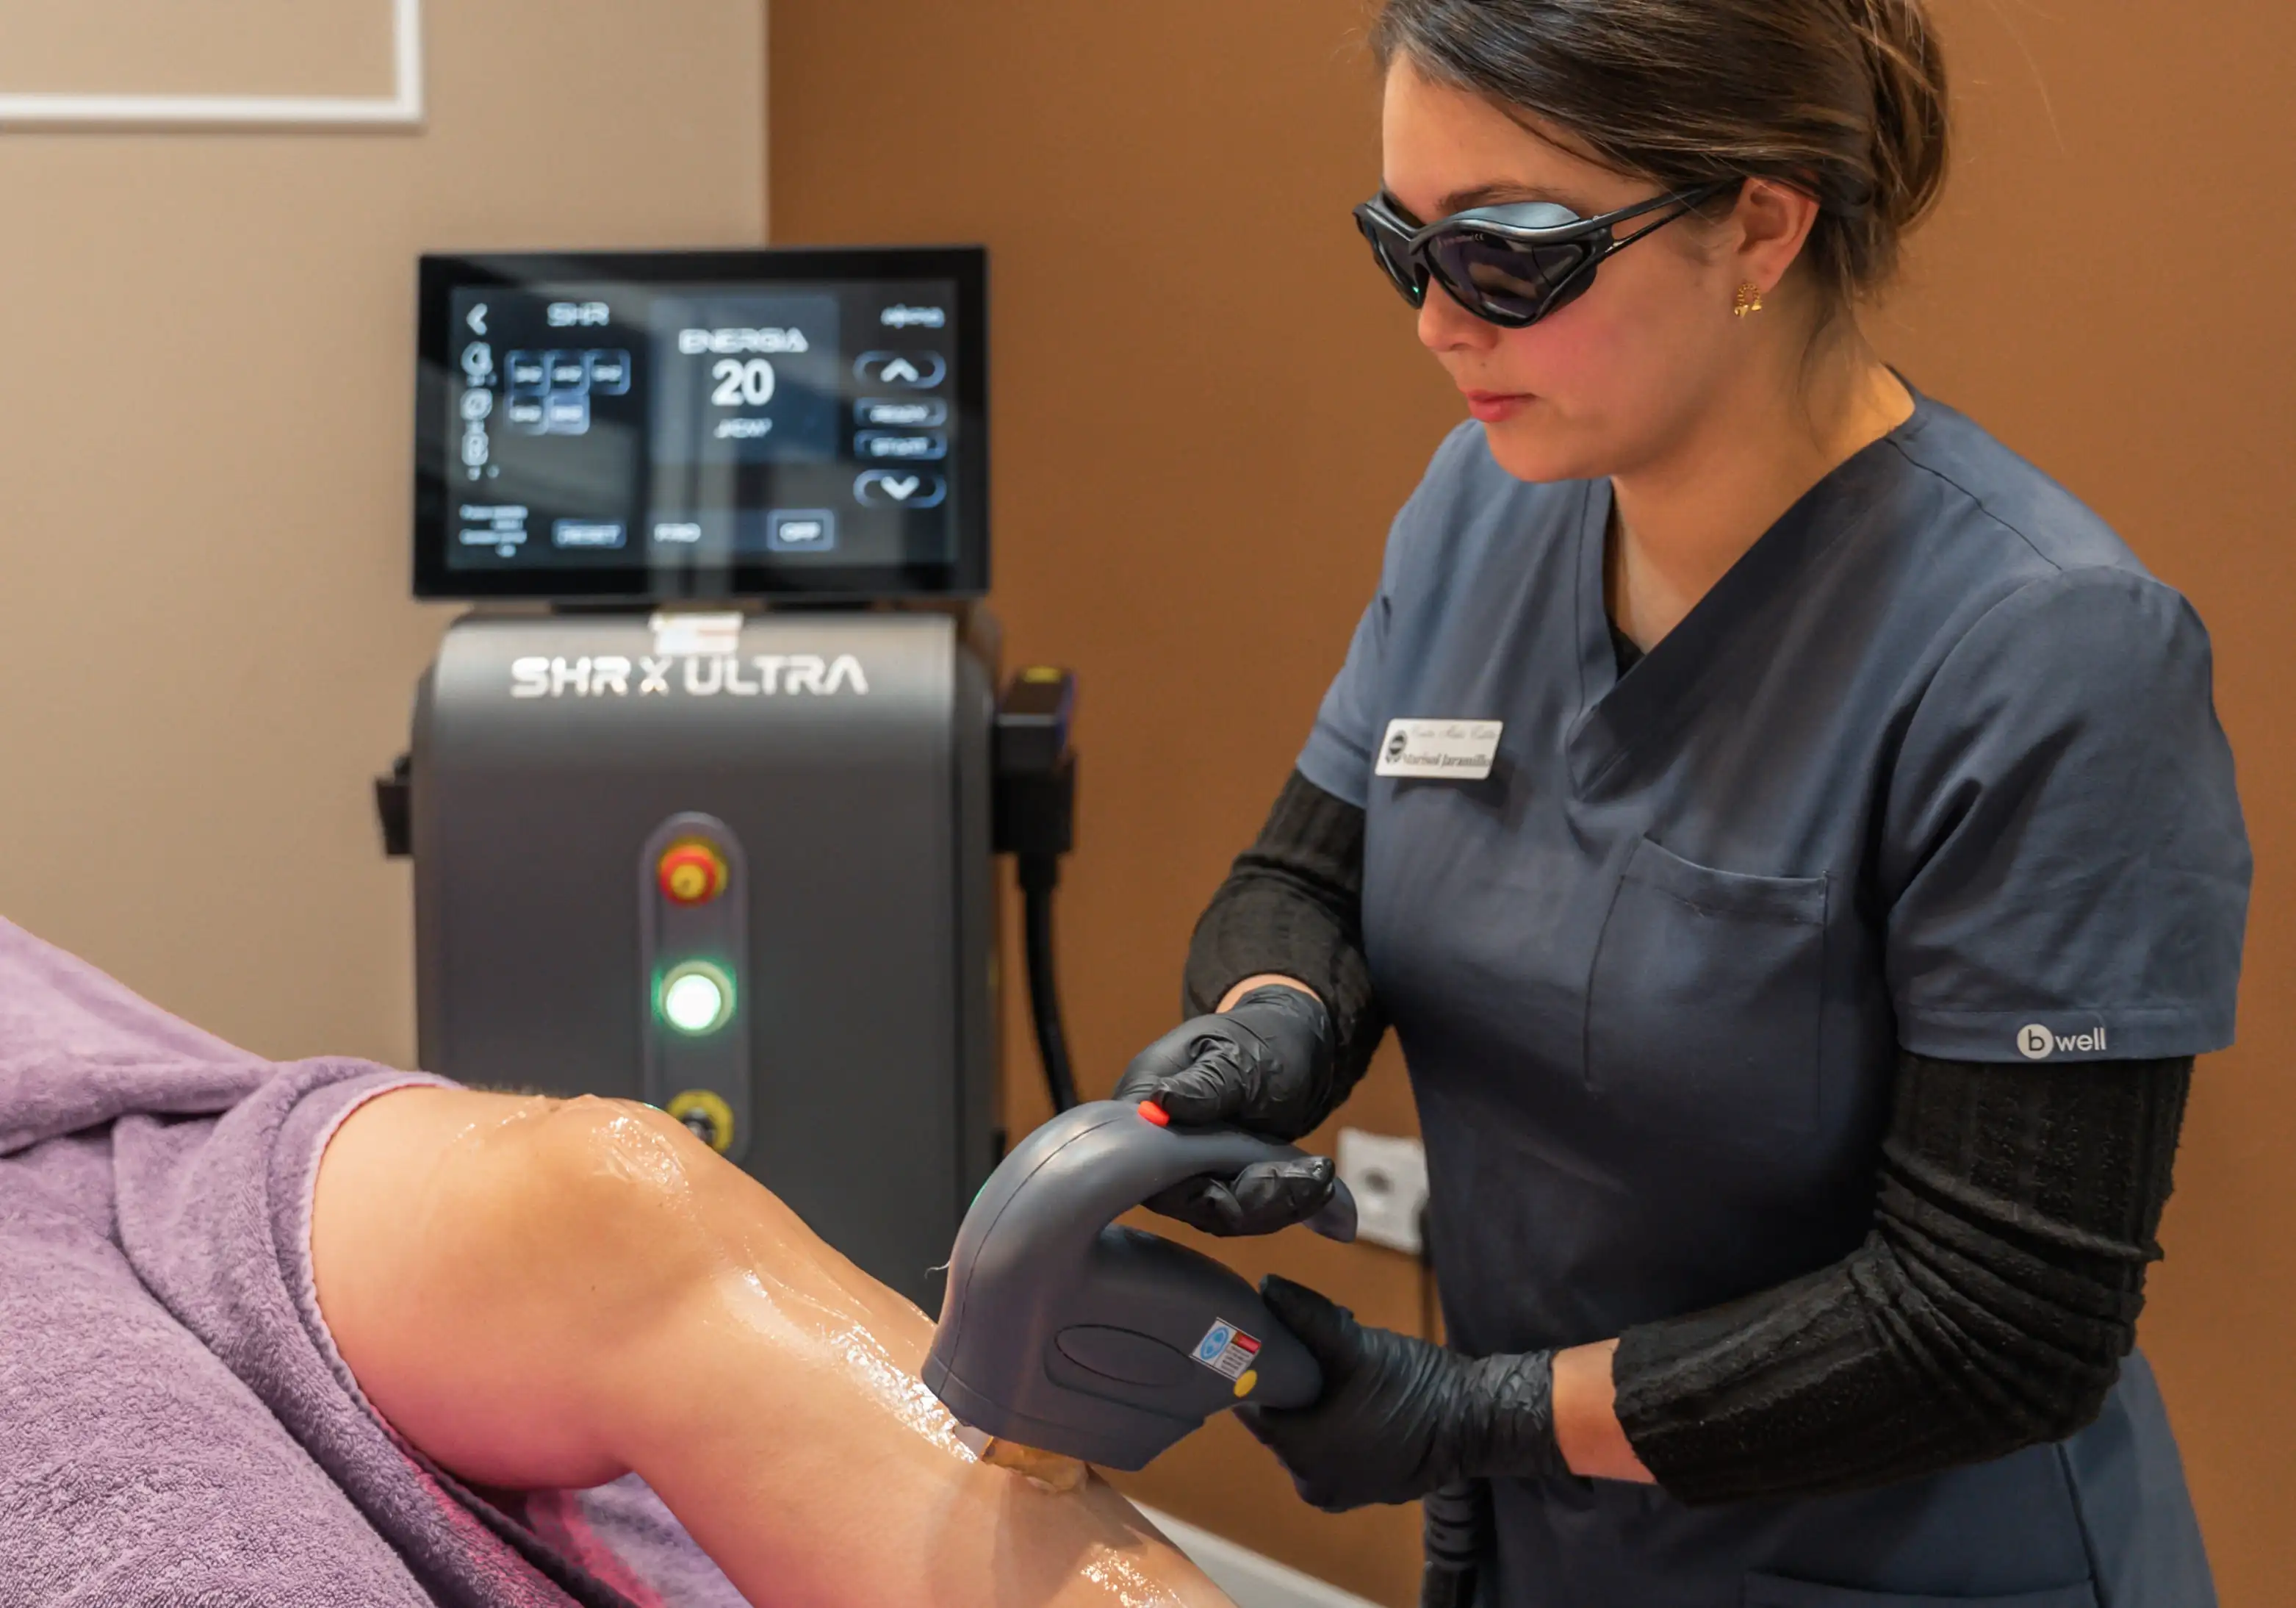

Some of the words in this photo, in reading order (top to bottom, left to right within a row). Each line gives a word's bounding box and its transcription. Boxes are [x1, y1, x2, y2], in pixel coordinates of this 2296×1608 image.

[711, 358, 775, 406] 20
[511, 656, 631, 697] SHR
[684, 654, 868, 695] ULTRA
